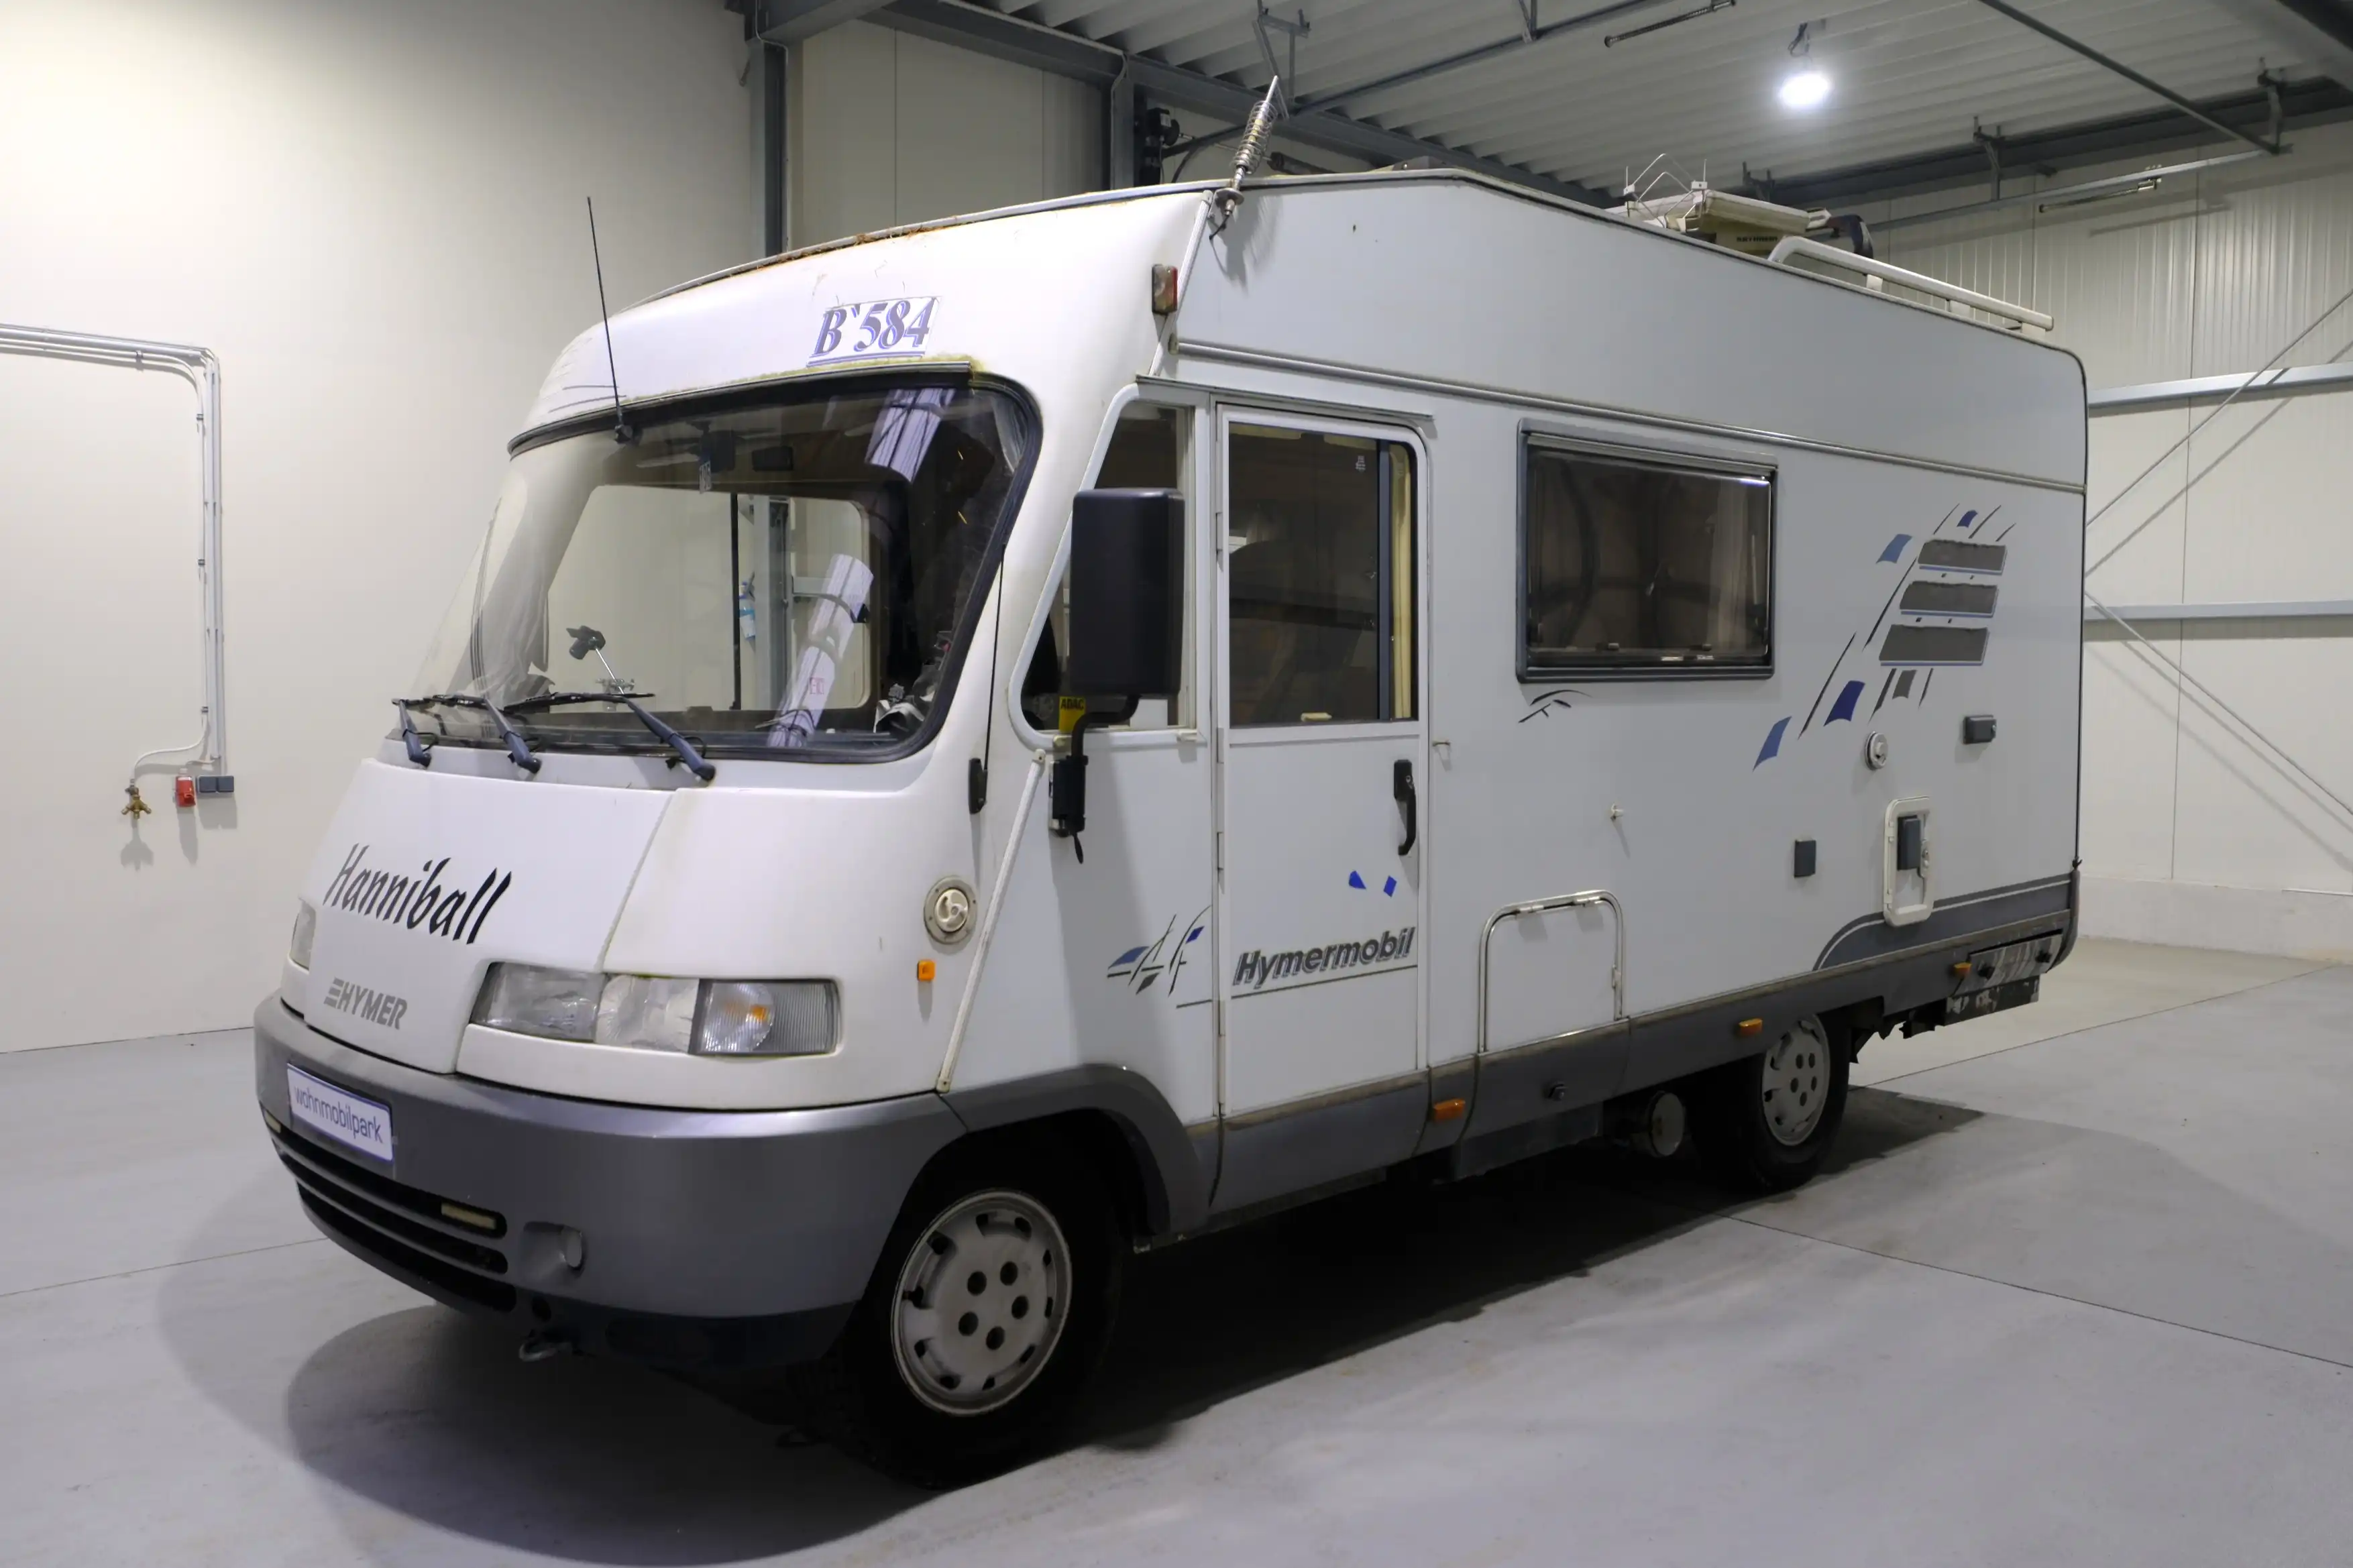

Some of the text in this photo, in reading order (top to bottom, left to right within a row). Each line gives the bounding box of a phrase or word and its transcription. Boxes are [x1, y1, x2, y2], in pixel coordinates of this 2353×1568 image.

[1060, 698, 1084, 710] ADAC
[323, 843, 511, 945] Hanniball
[1232, 926, 1416, 990] Hymermobil
[336, 981, 408, 1030] HYMER
[294, 1086, 383, 1143] wohnmobilpark
